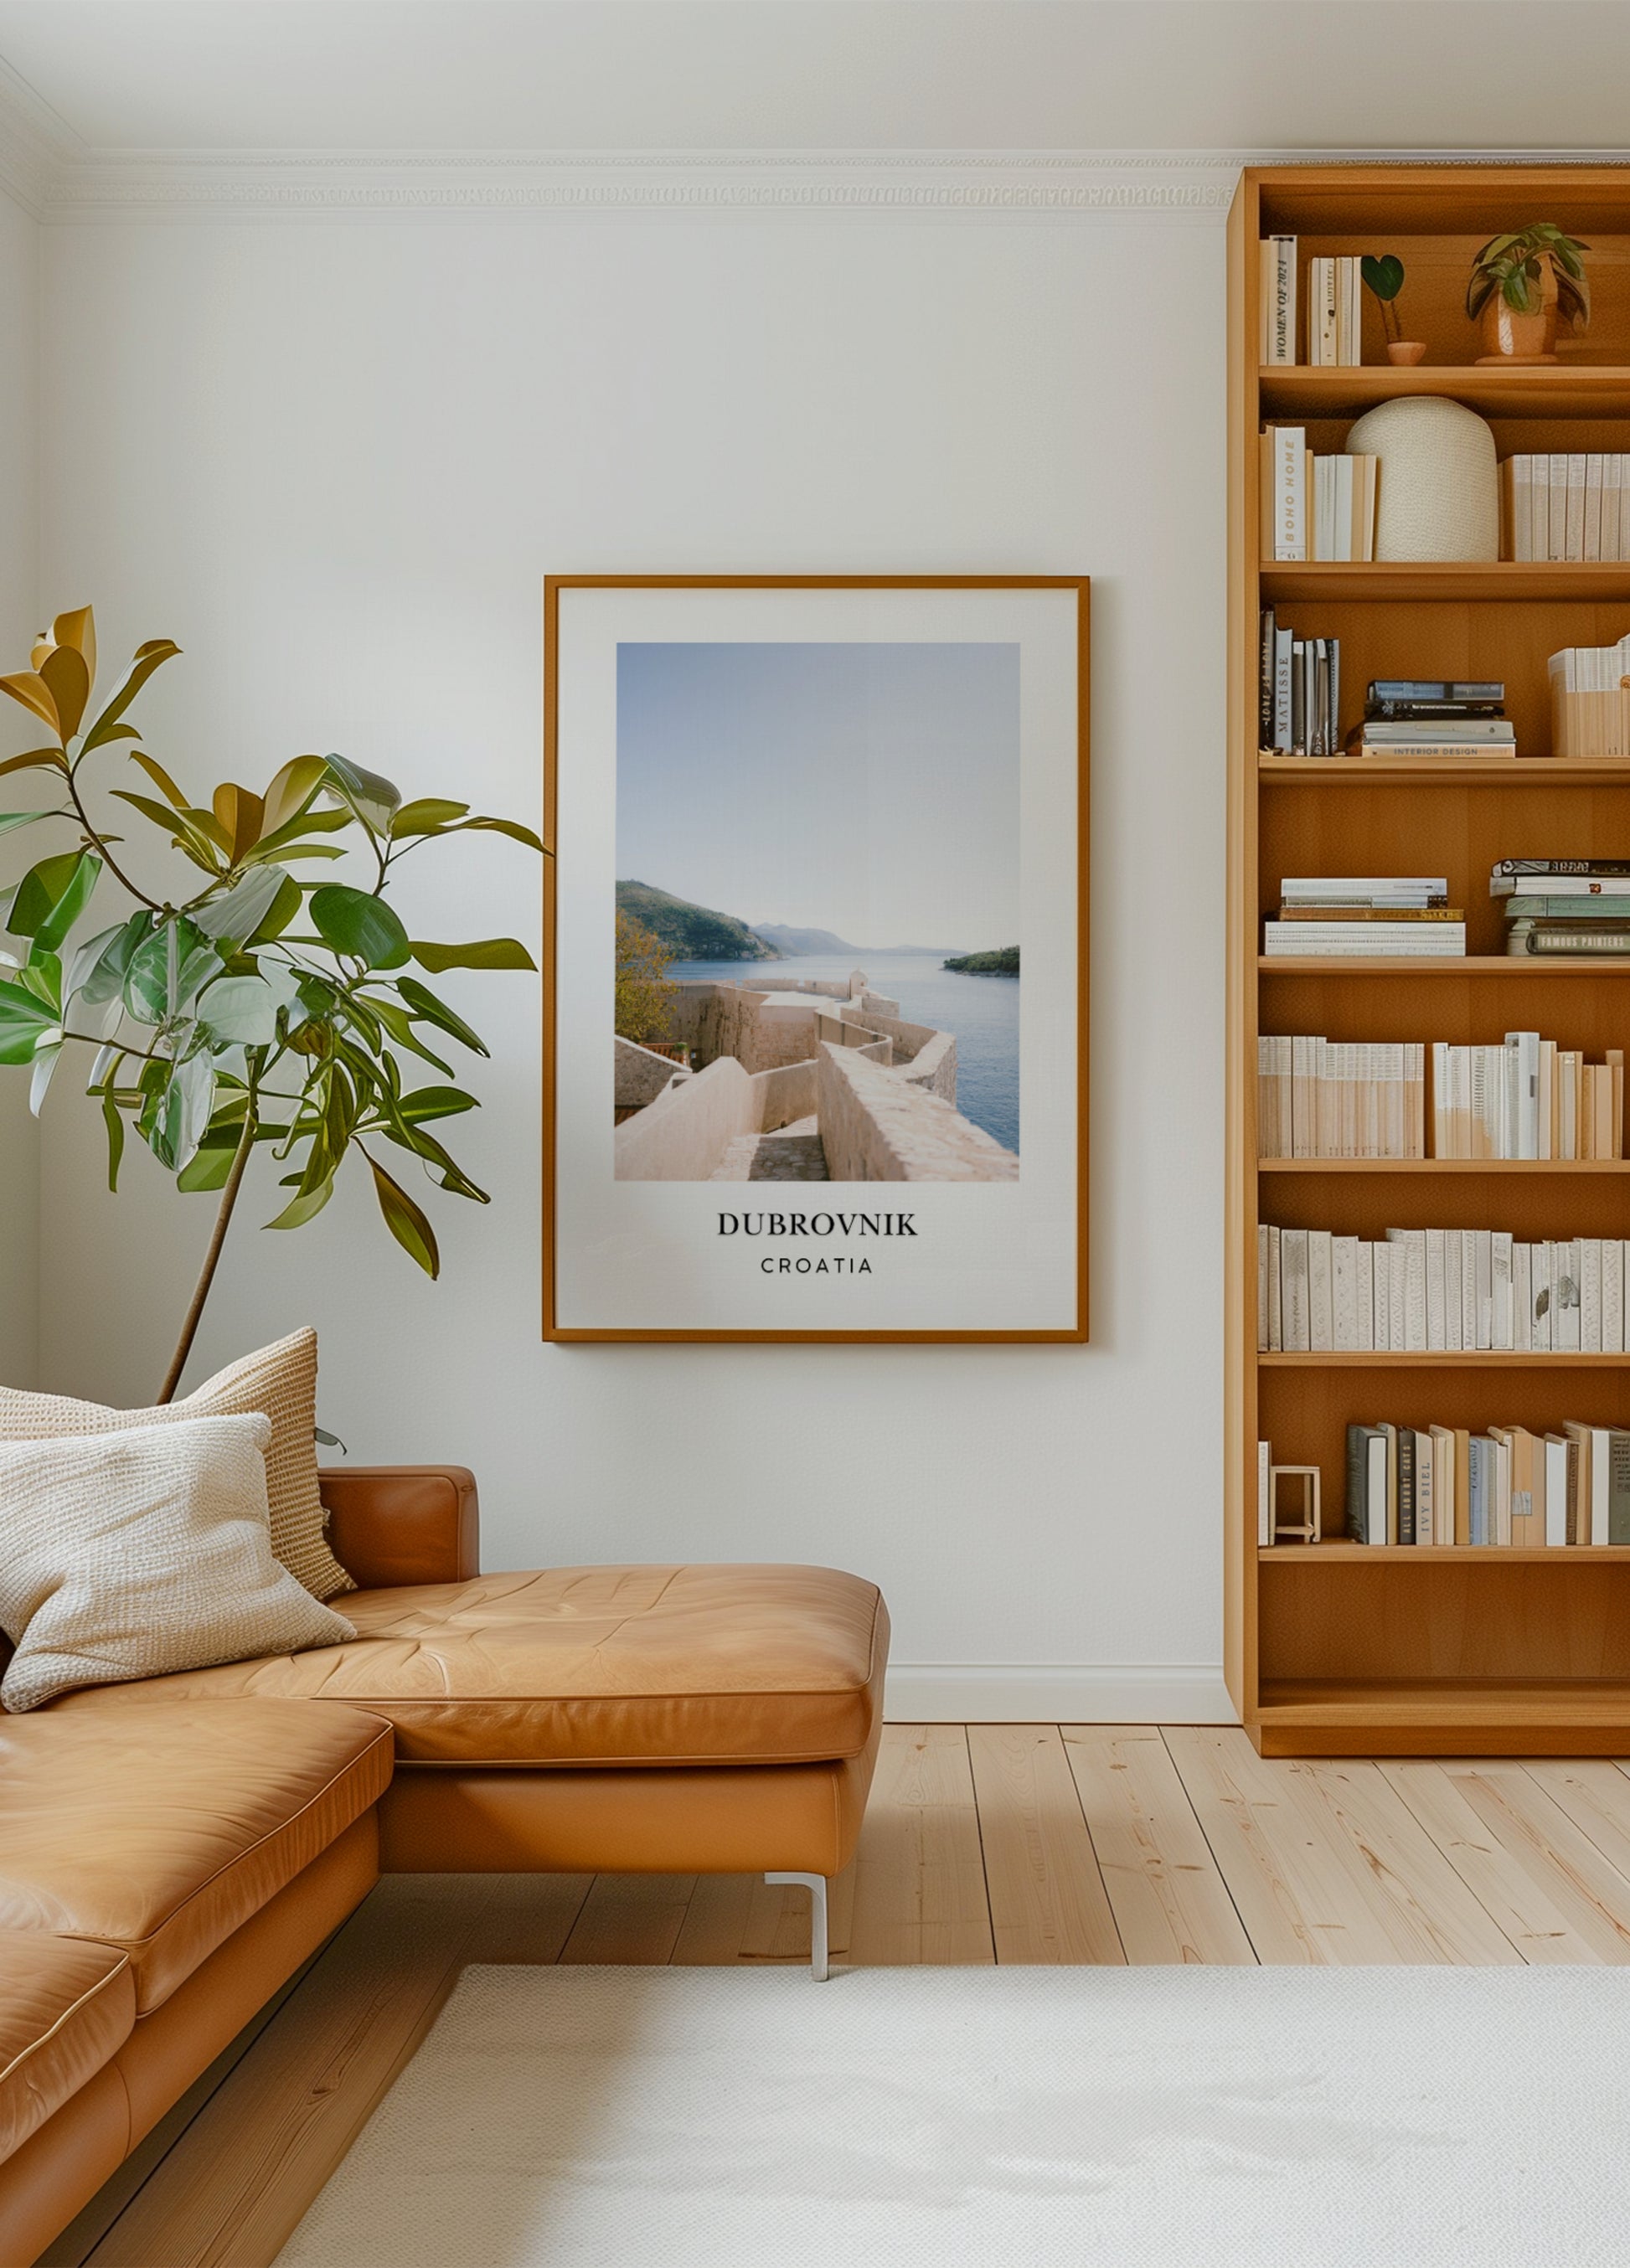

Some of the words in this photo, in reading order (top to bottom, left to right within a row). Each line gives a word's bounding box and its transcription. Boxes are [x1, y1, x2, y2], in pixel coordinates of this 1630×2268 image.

[1277, 260, 1287, 288] 2024
[1277, 288, 1287, 306] OF
[1277, 307, 1287, 358] WOMEN
[1285, 440, 1295, 487] HOME
[1285, 495, 1295, 542] BOHO
[1278, 657, 1288, 733] MATISSE
[1540, 936, 1578, 947] FAMOUS
[1581, 936, 1625, 947] PAINTERS
[717, 1213, 919, 1236] DUBROVNIK
[761, 1257, 873, 1274] CROATIA
[1403, 1445, 1411, 1471] CATS
[1402, 1477, 1411, 1509] ABOUT
[1421, 1462, 1431, 1497] BIEL
[1402, 1515, 1411, 1534] ALL
[1421, 1506, 1430, 1532] IVY
